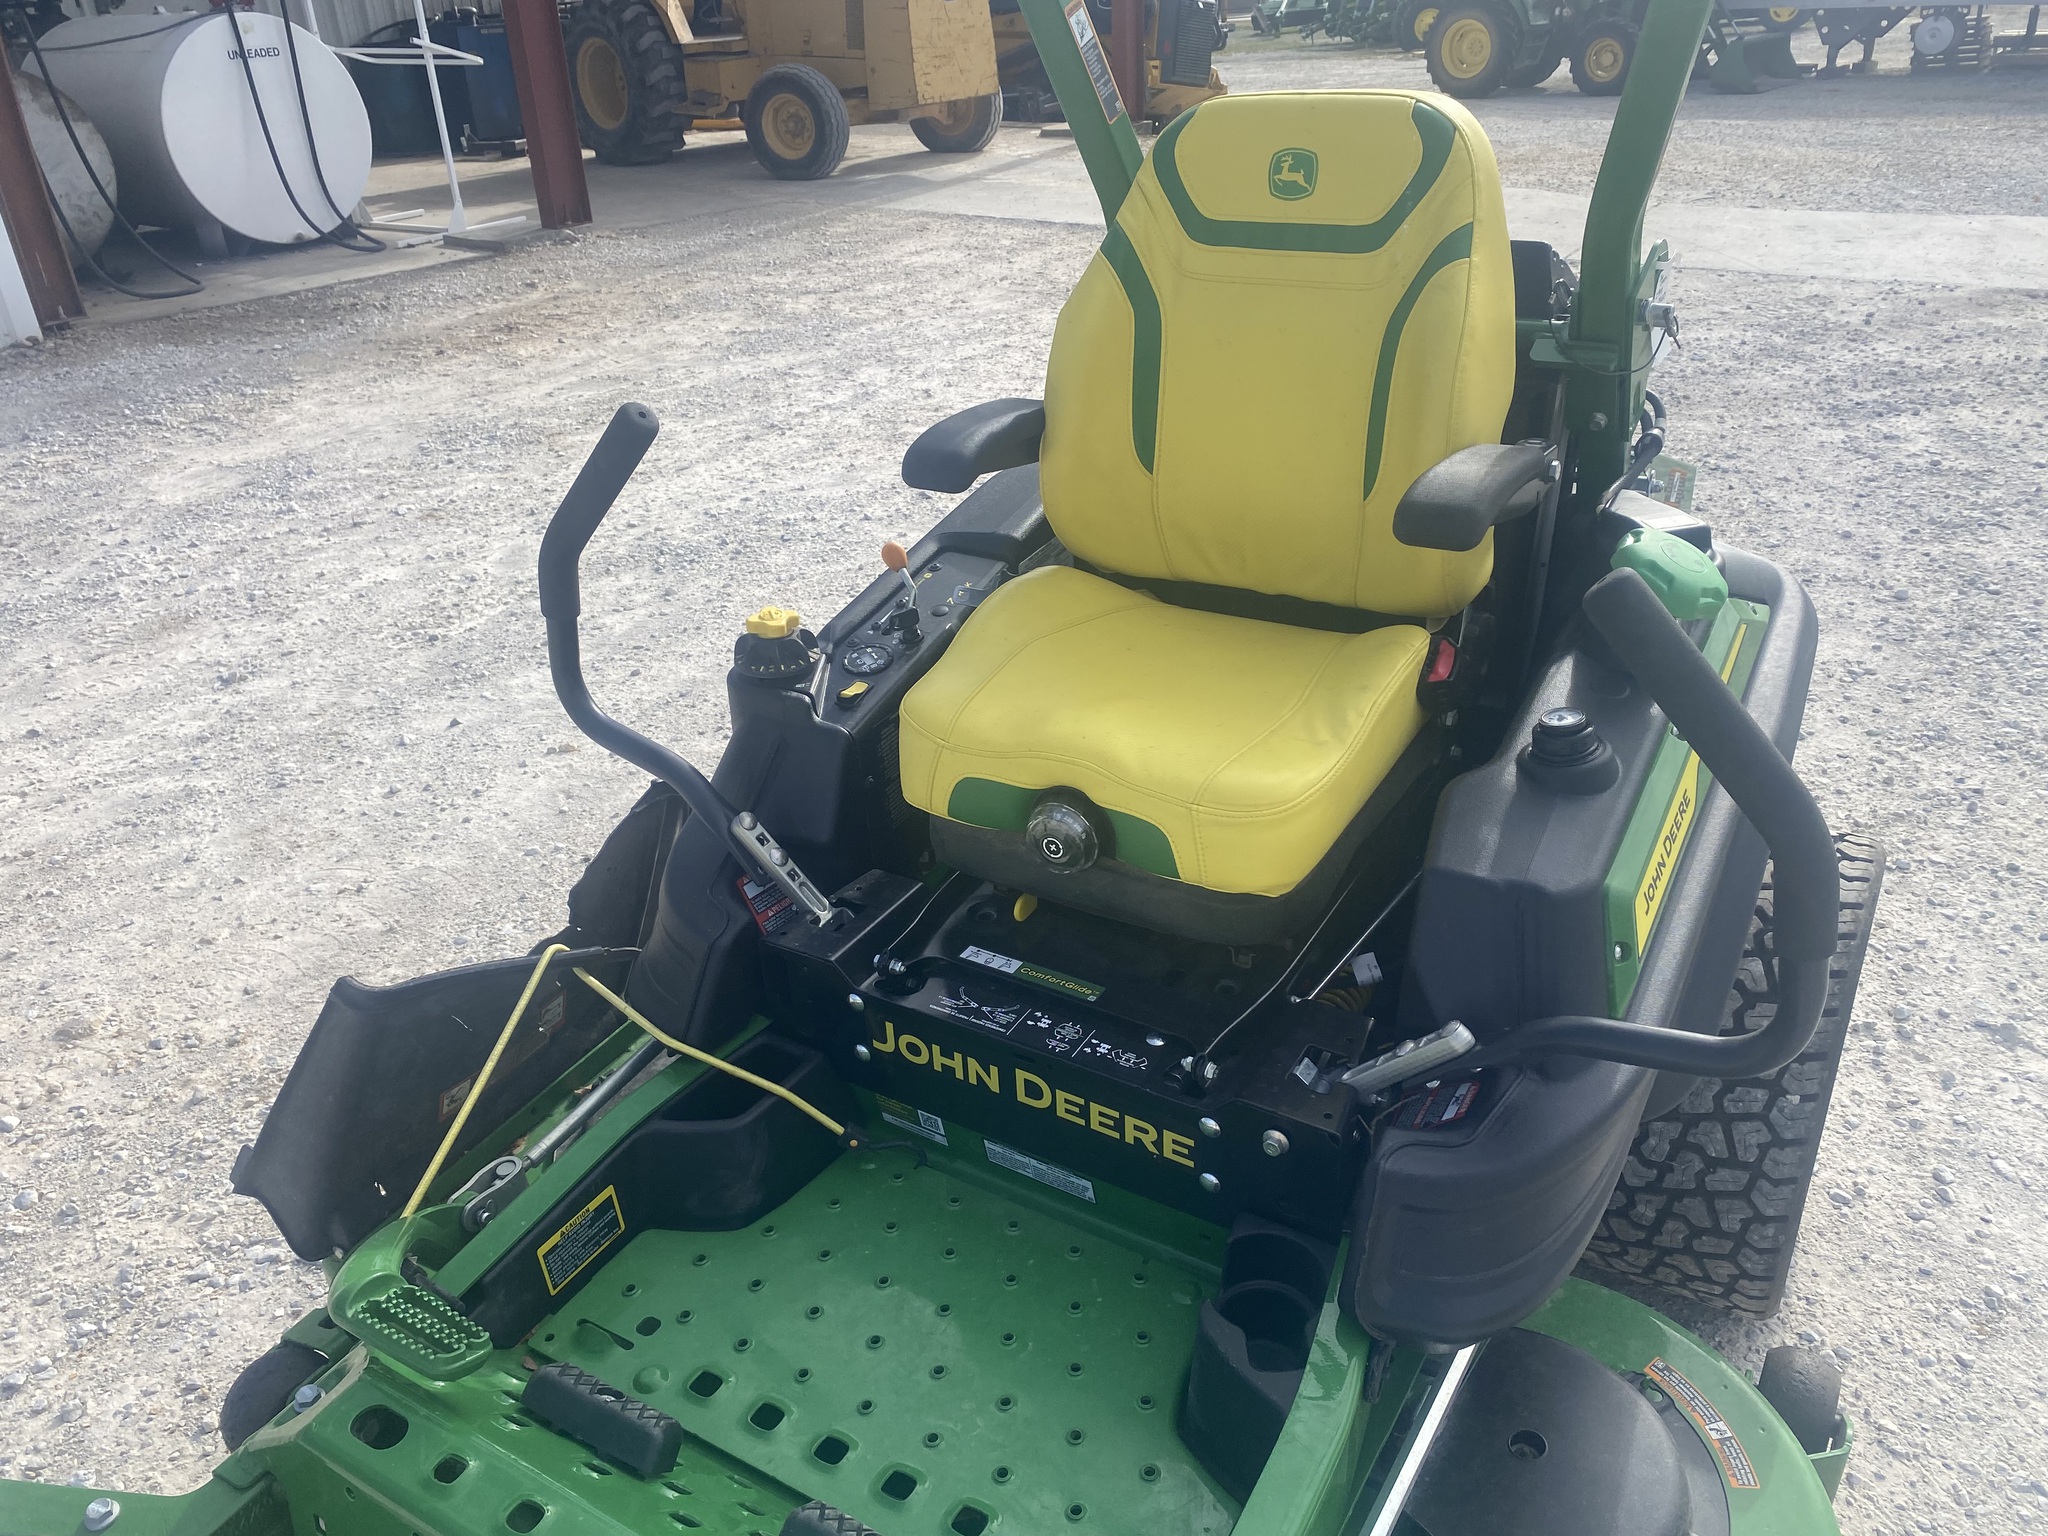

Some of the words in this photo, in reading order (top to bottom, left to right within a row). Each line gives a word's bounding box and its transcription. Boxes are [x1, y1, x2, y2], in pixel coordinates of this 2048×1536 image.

[1643, 853, 1667, 916] JOHN
[1662, 788, 1691, 859] DEERE
[872, 1021, 1000, 1094] JOHN
[1015, 1067, 1195, 1168] DEERE
[565, 1206, 591, 1233] CAUTION
